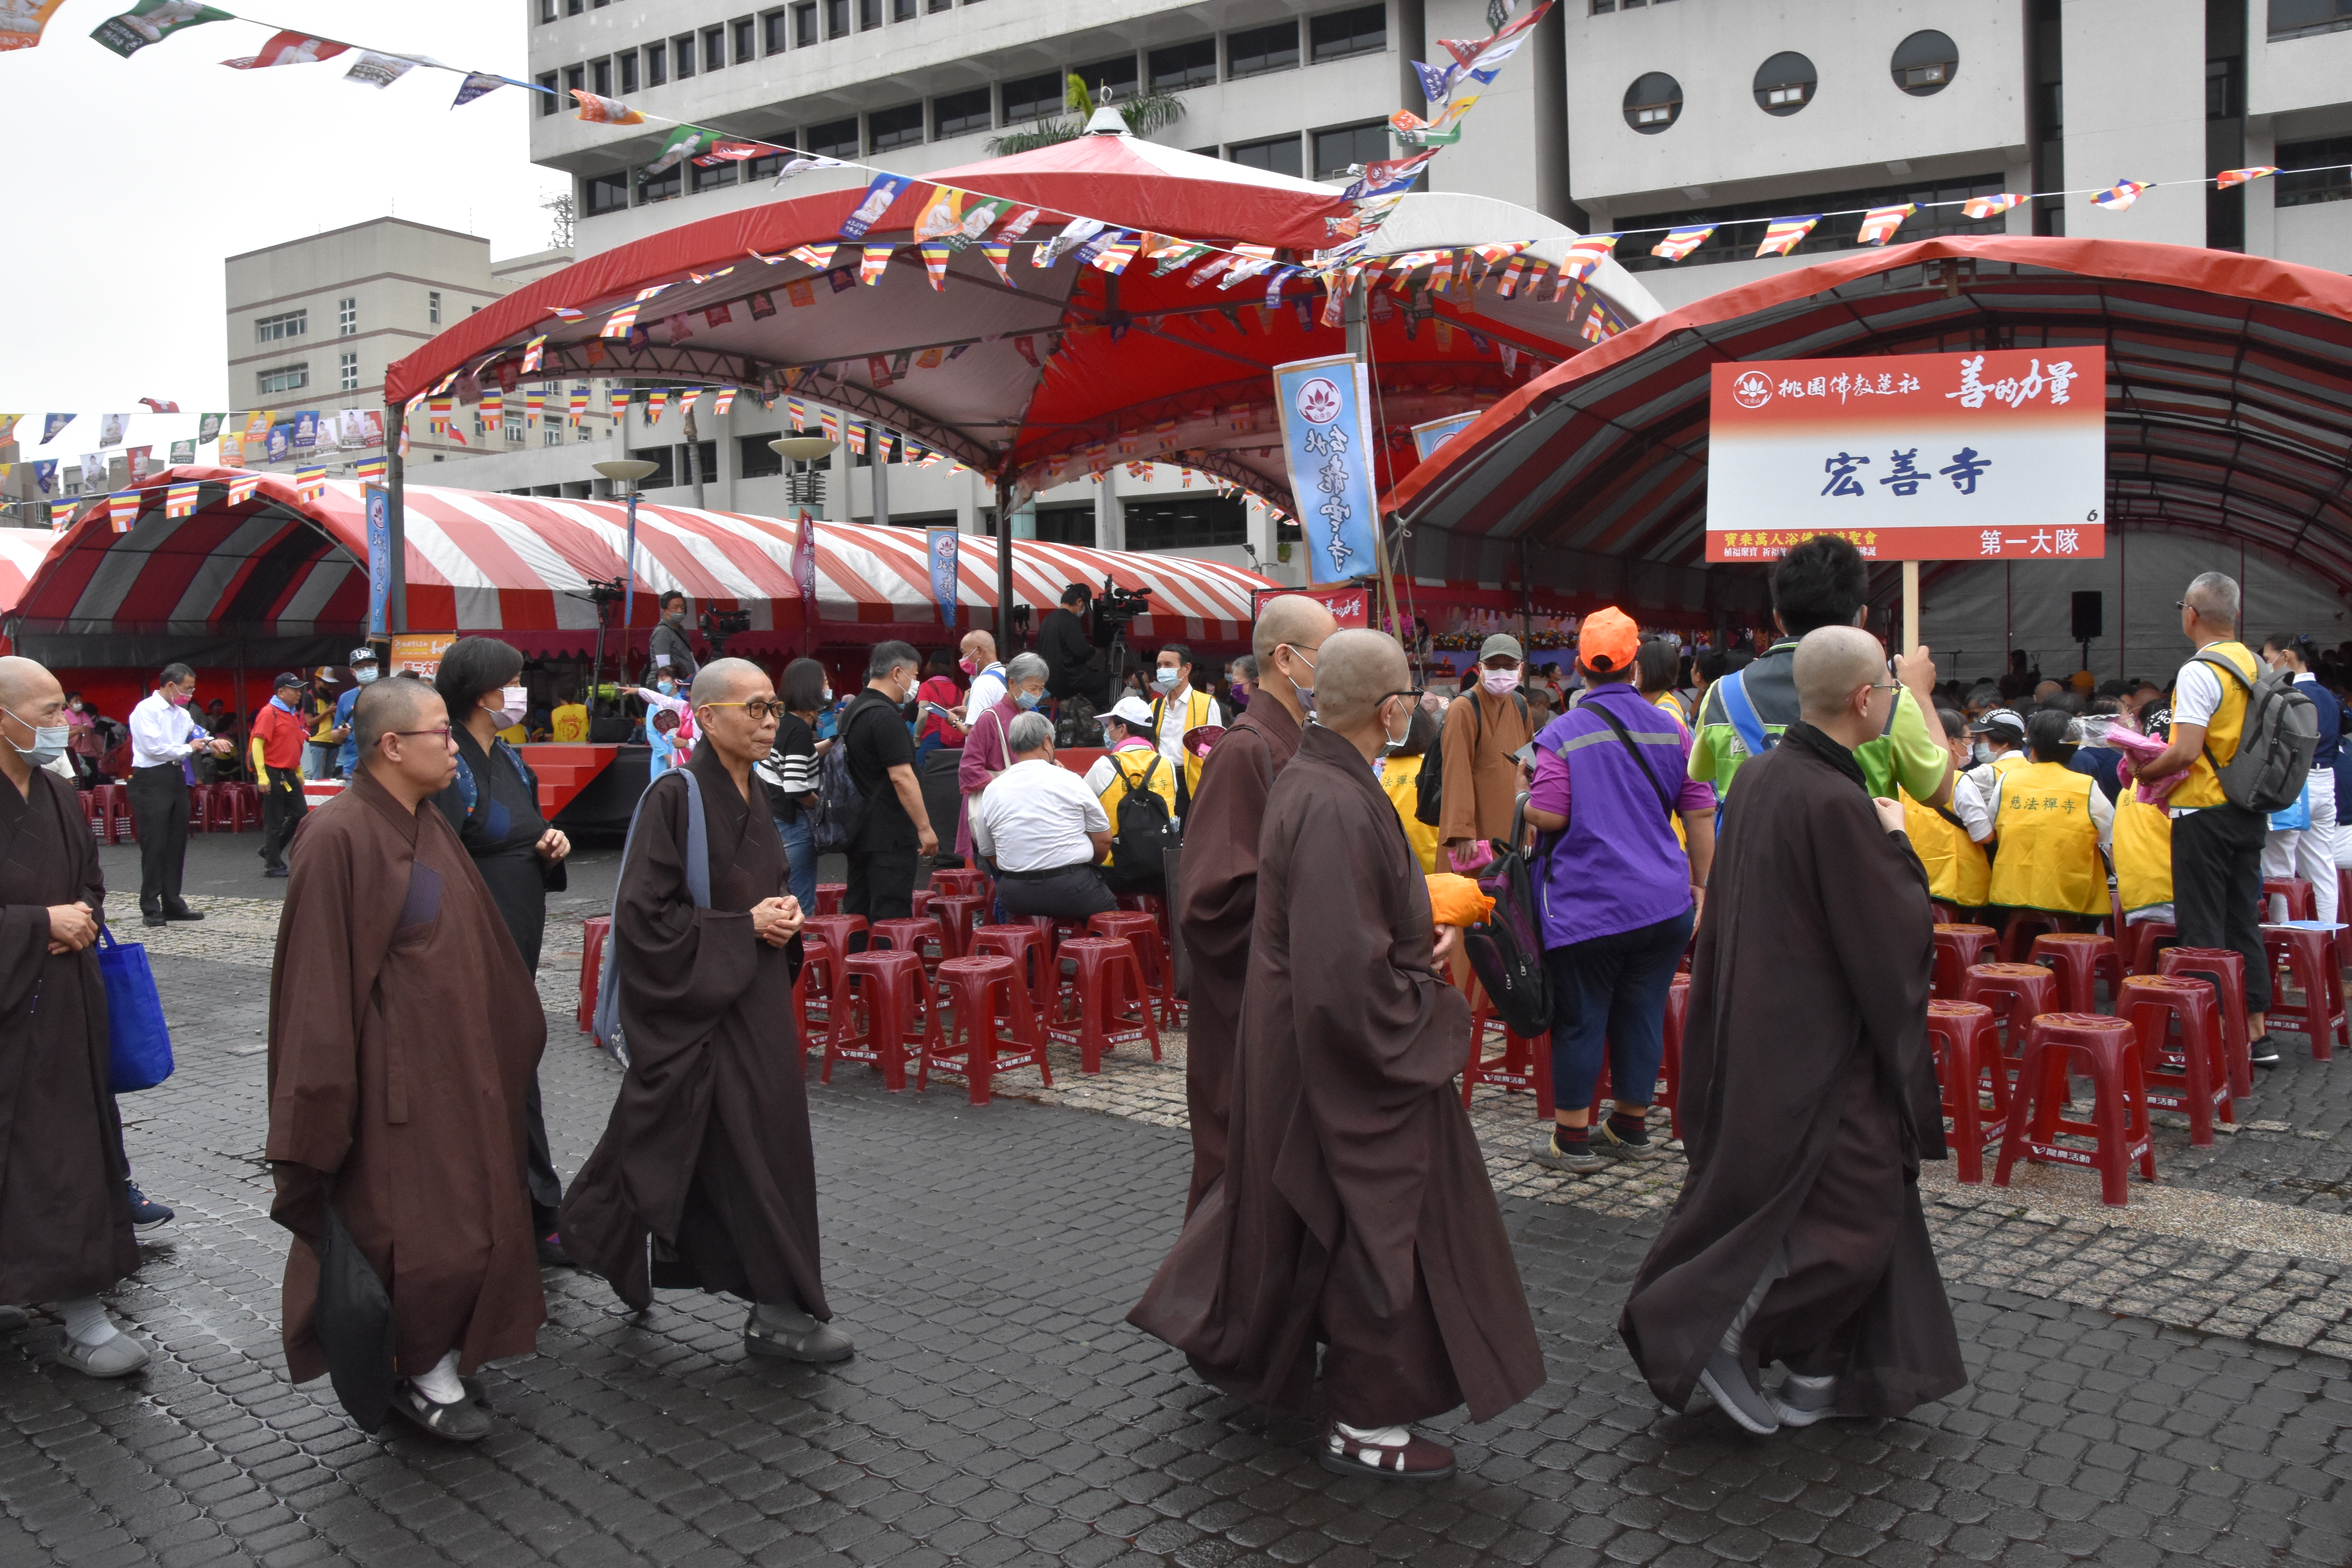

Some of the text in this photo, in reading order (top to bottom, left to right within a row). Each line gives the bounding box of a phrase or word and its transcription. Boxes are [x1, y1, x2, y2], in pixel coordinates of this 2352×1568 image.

[1778, 372, 1920, 405] 桃園佛教蓮社
[1945, 355, 2078, 408] 善的力量
[1821, 447, 1991, 496] 宏善寺
[2087, 510, 2098, 522] 6
[1724, 530, 1877, 547] 寶乘萬人浴佛聖會
[1980, 528, 2079, 555] 第一大隊
[2010, 795, 2076, 814] 慈法禪寺
